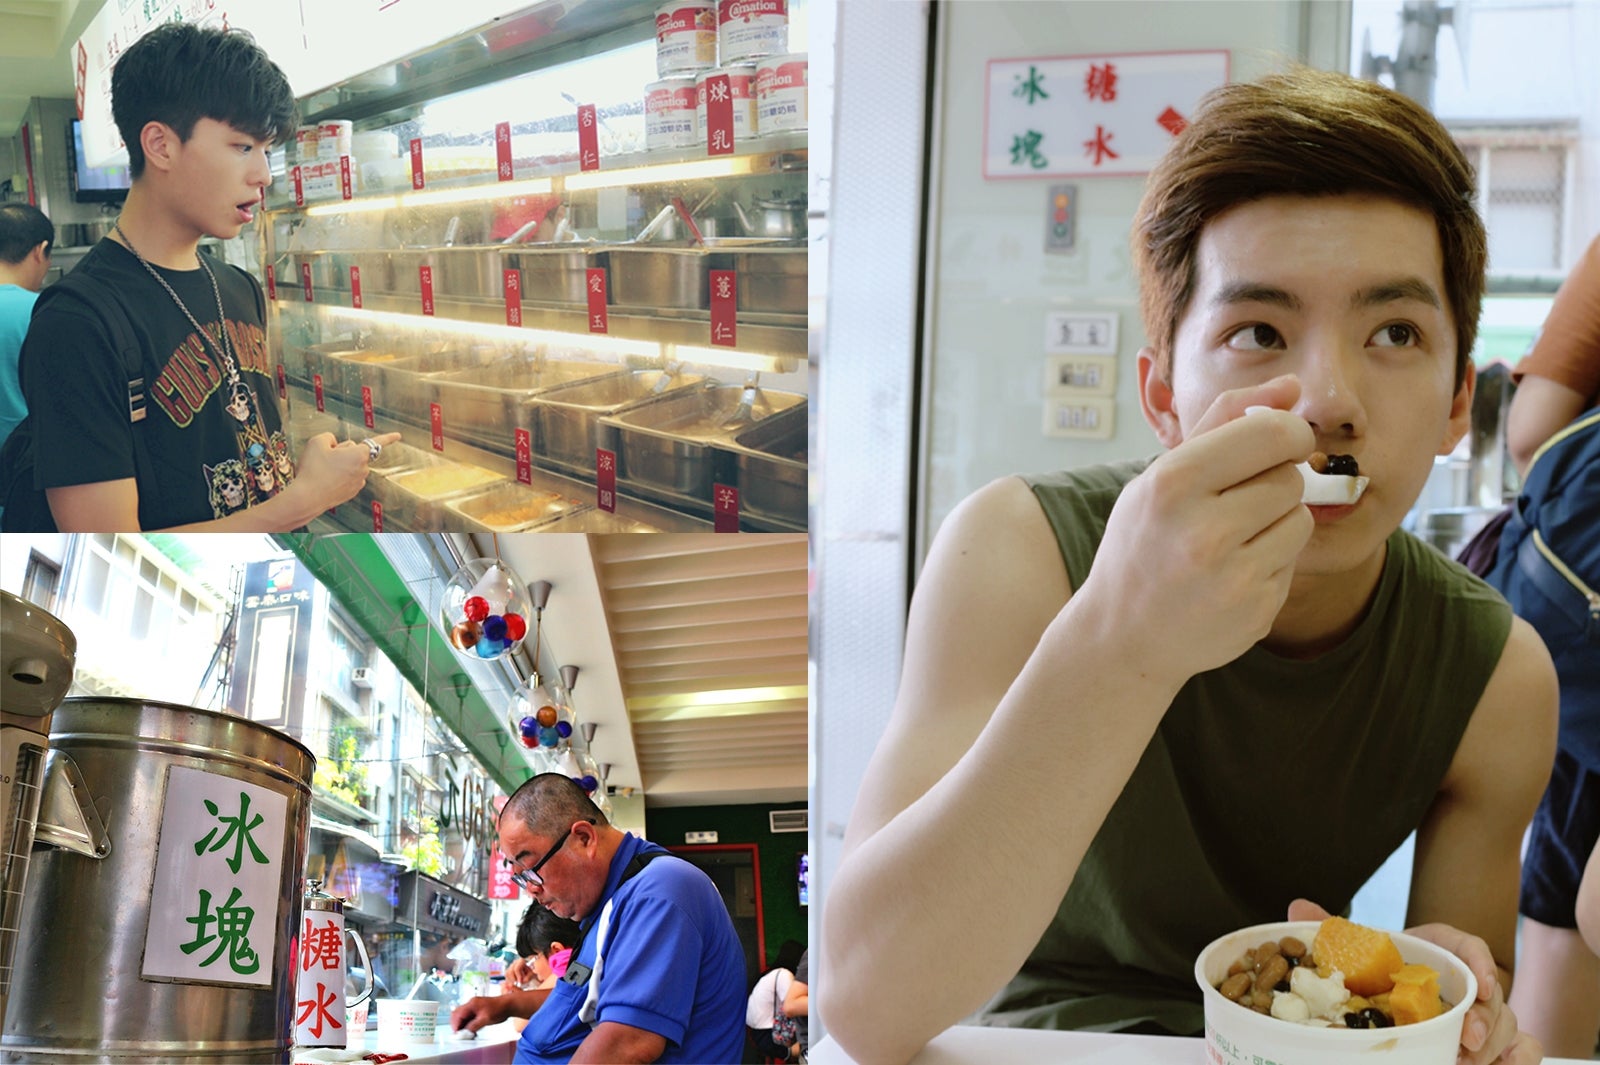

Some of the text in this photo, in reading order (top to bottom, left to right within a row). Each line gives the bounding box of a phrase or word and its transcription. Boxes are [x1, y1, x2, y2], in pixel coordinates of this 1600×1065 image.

[581, 109, 598, 166] 杏仁
[710, 80, 731, 150] 煉乳
[1010, 65, 1050, 170] 冰塊
[1083, 61, 1120, 167] 糖水
[589, 274, 605, 329] 愛玉
[714, 276, 733, 340] 薏仁
[151, 333, 222, 428] GUNS
[180, 791, 270, 975] 冰塊
[297, 917, 343, 1039] 糖水
